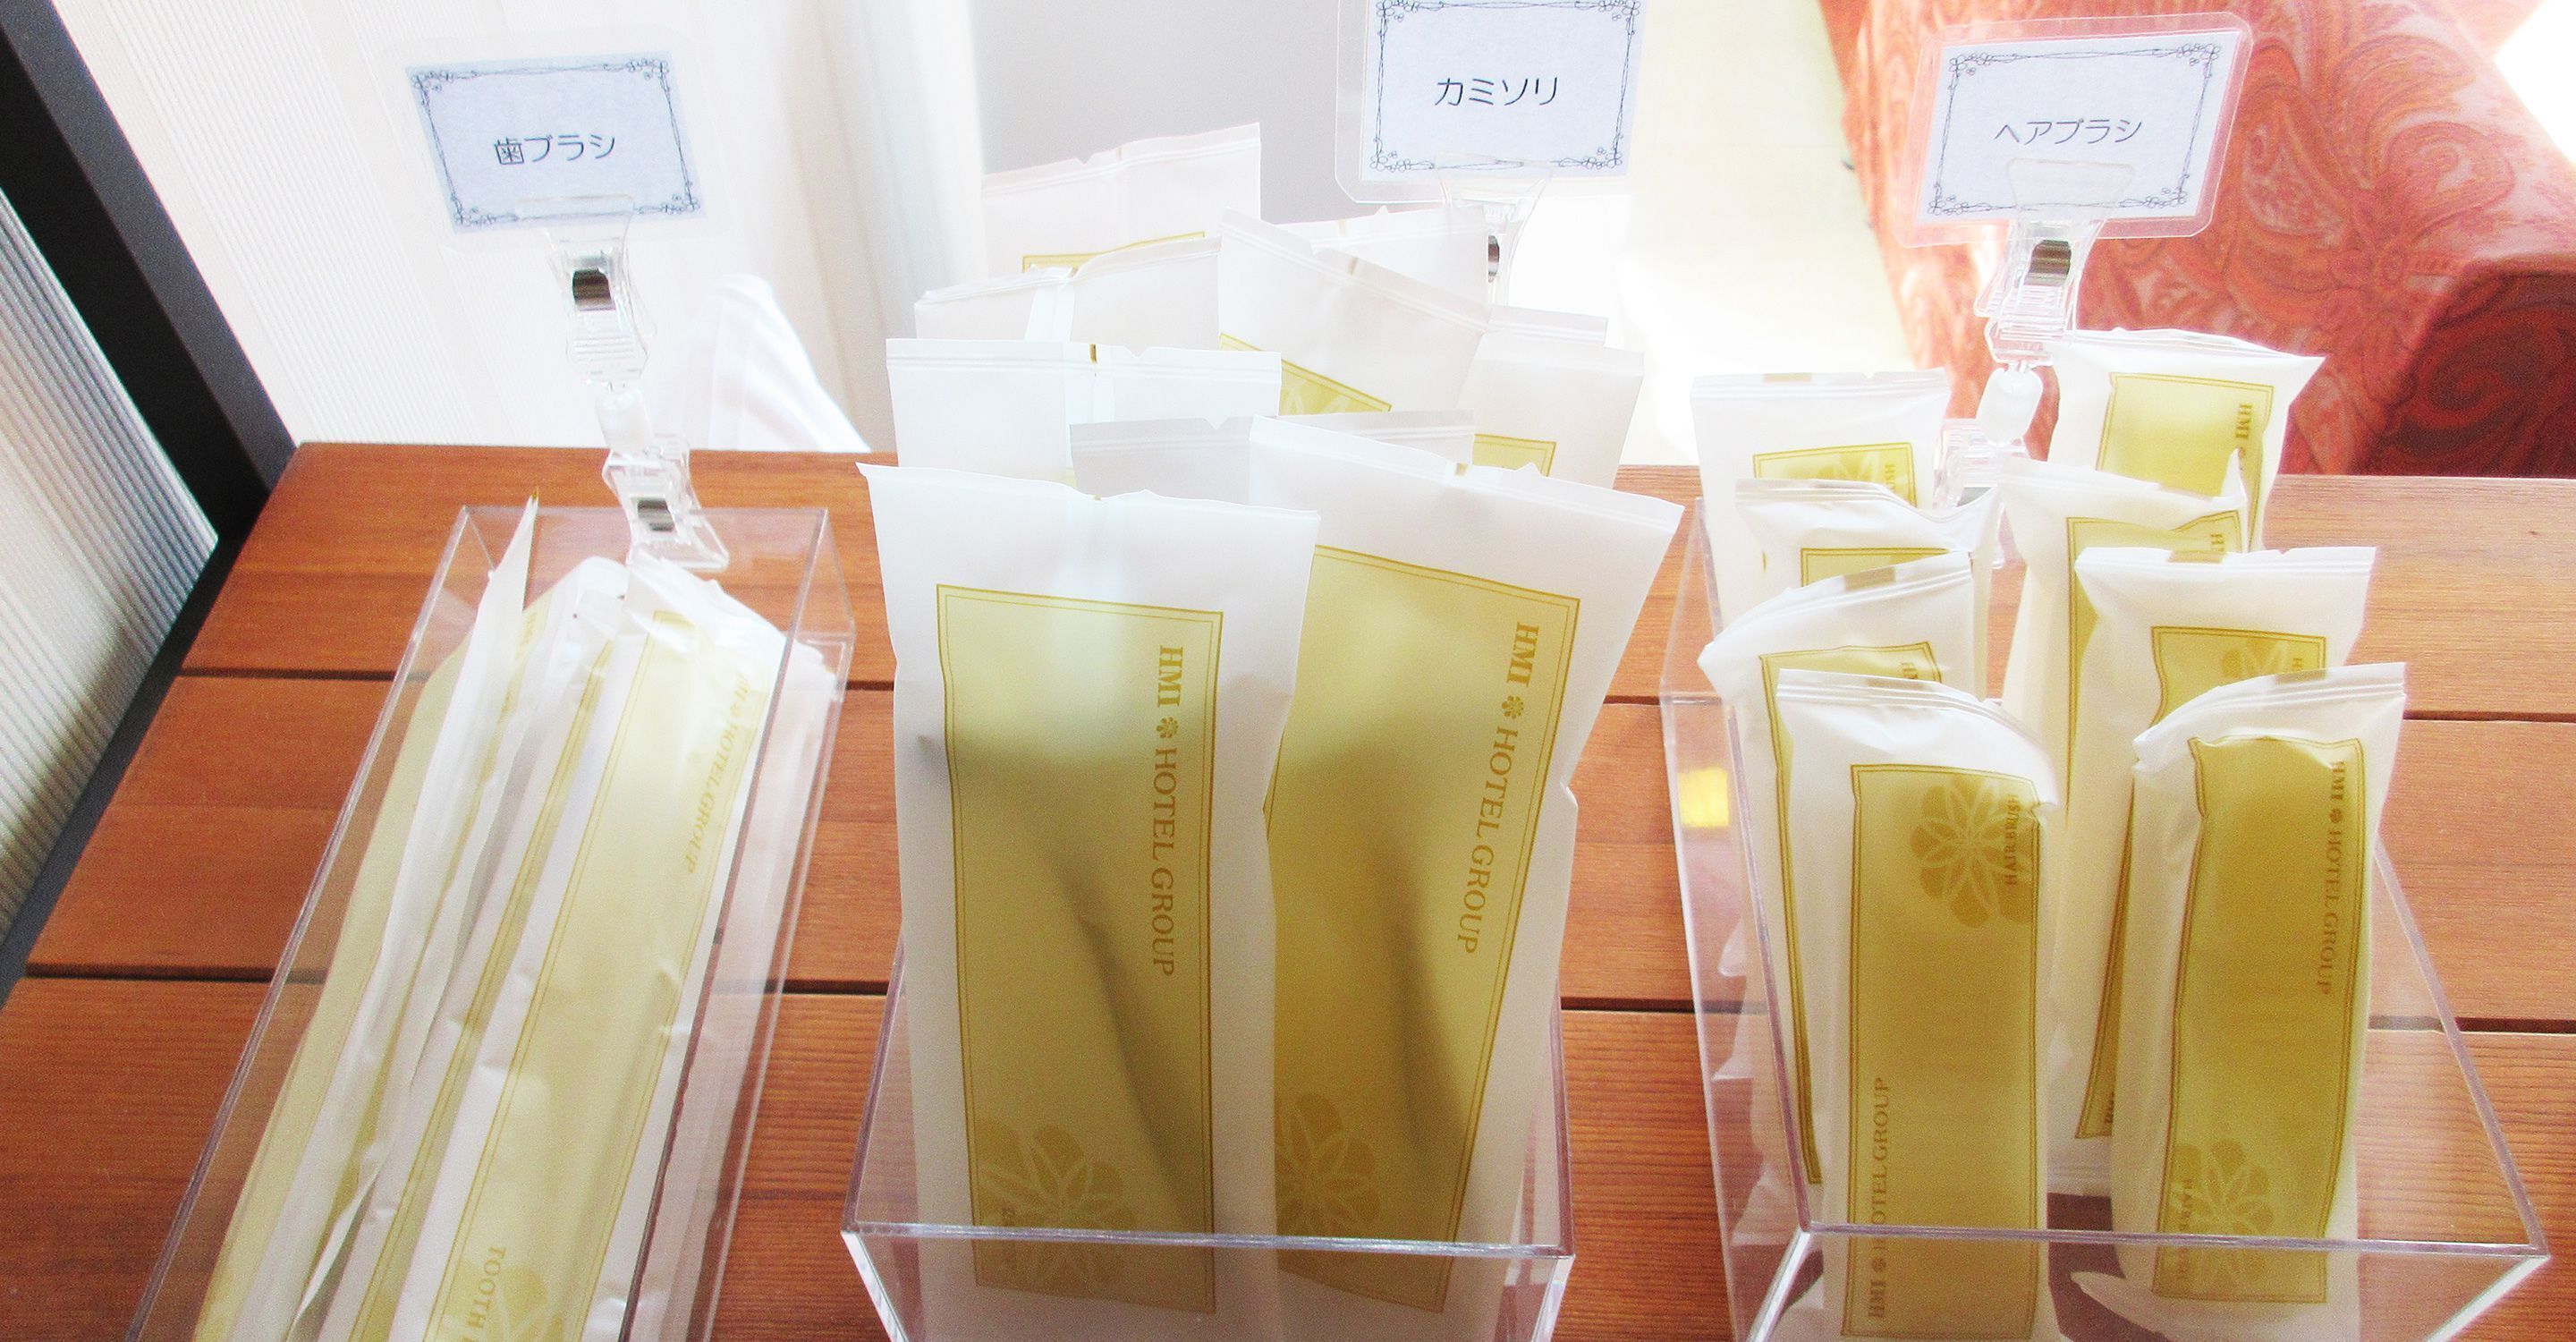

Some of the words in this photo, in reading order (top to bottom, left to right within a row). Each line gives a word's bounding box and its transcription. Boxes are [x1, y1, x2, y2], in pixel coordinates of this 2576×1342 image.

[1435, 77, 1557, 106] カミソリ
[494, 134, 615, 165] 歯ブラシ
[1994, 117, 2142, 146] ヘアブラシ
[2236, 403, 2252, 439] HMI
[1157, 645, 1184, 709] HMI
[1506, 622, 1539, 687] HMI
[1151, 747, 1178, 862] HOTEL
[1476, 726, 1520, 838] HOTEL
[685, 791, 716, 874] GROUP
[2004, 844, 2018, 885] HAIR
[2325, 829, 2343, 908] HOTEL
[1150, 867, 1176, 977] GROUP
[1456, 843, 1496, 956] GROUP
[2316, 912, 2339, 995] GROUP
[1871, 1076, 1890, 1161] GROUP
[466, 1246, 506, 1329] TOOTH
[1868, 1279, 1886, 1318] HMI
